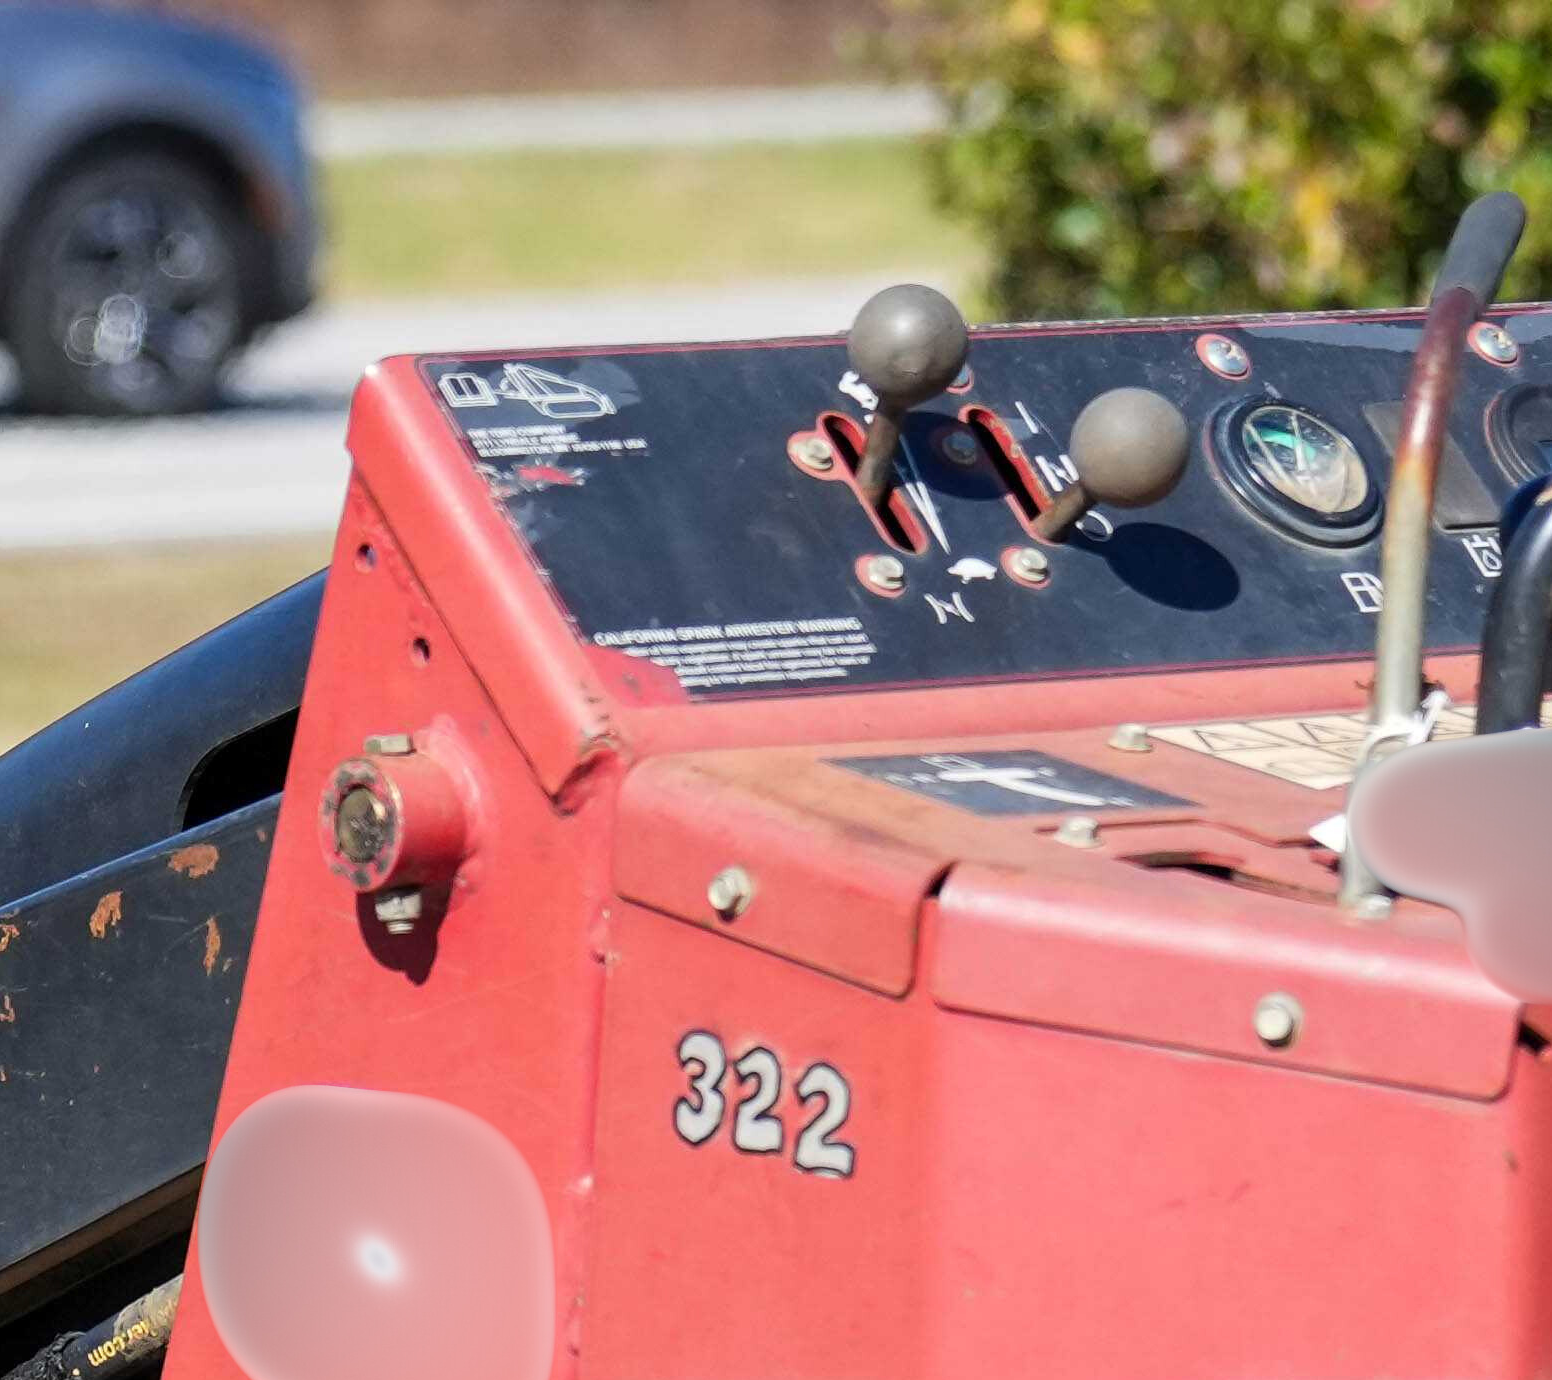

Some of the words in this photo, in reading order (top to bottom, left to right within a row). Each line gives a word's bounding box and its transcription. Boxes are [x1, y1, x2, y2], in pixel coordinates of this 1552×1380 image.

[593, 627, 678, 647] CALIFORNIA
[676, 625, 726, 642] SPARK
[724, 620, 799, 638] ARRESTER
[796, 617, 864, 634] WARNING
[674, 1029, 854, 1176] 322
